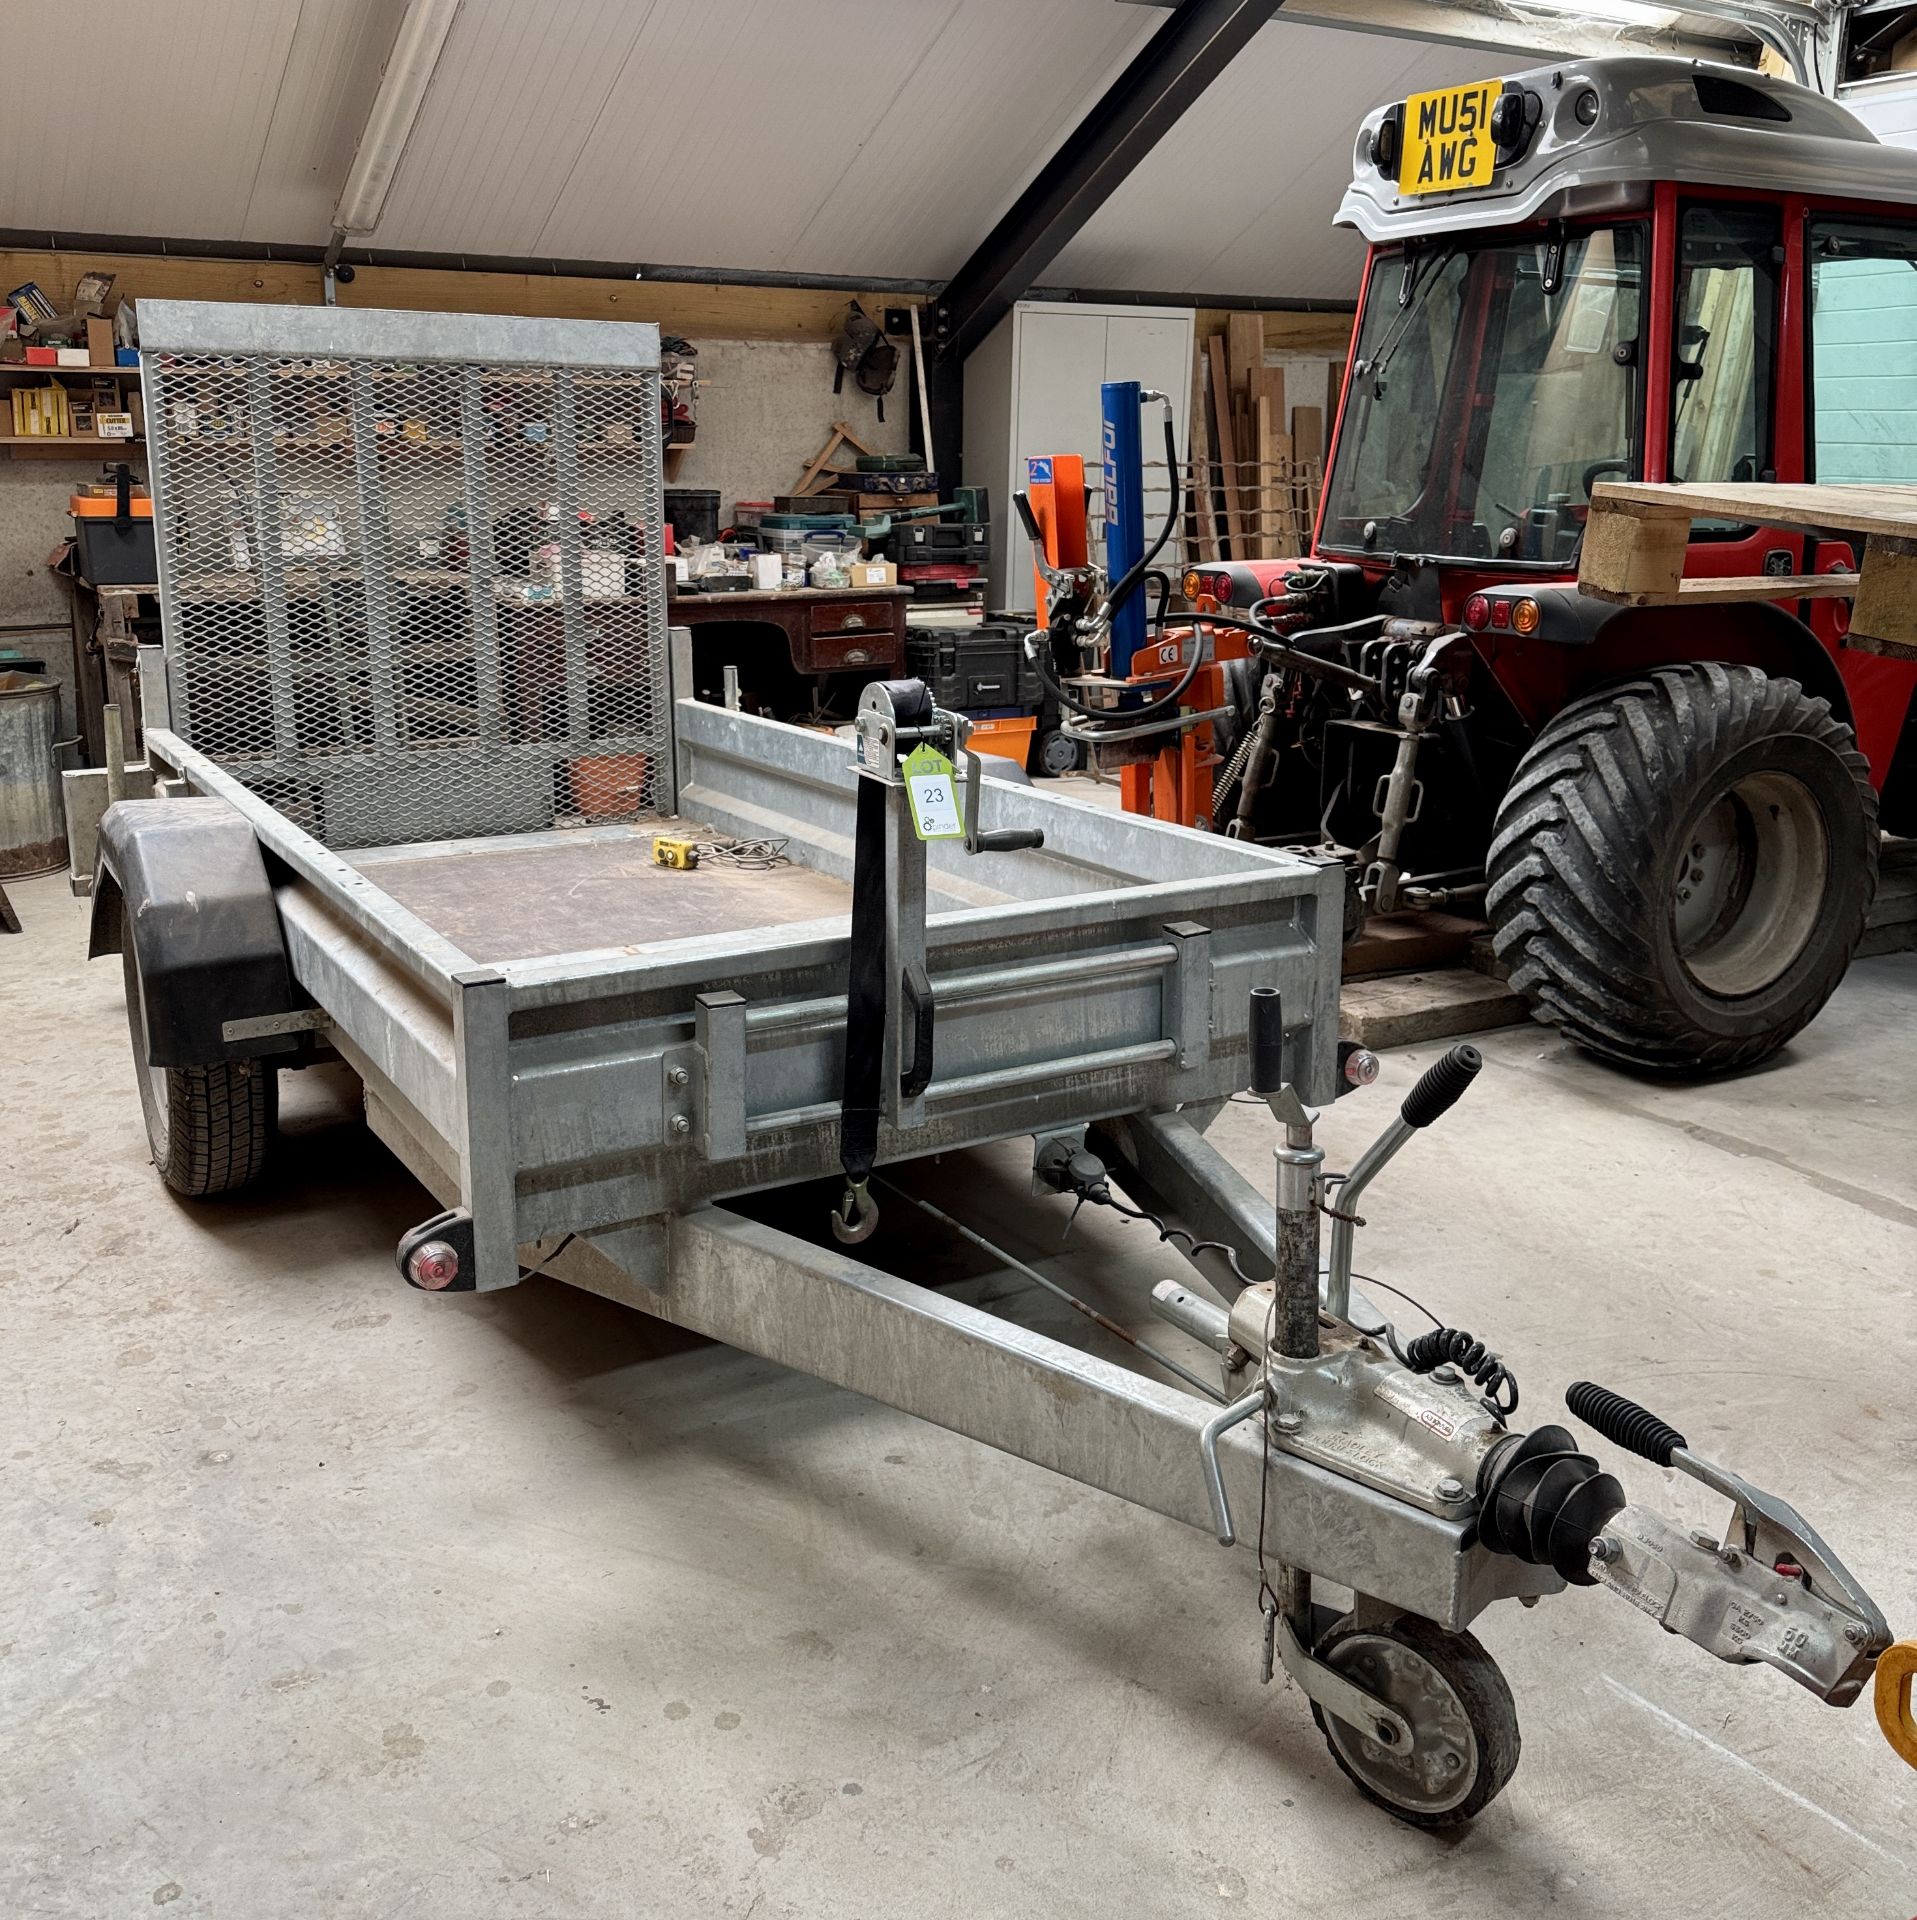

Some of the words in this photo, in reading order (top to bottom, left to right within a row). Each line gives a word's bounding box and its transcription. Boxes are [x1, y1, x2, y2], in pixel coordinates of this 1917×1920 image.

[1418, 89, 1488, 140] MU51
[1417, 138, 1478, 184] AWG
[1161, 647, 1174, 662] CE
[912, 760, 943, 774] LOT
[924, 788, 944, 803] 23
